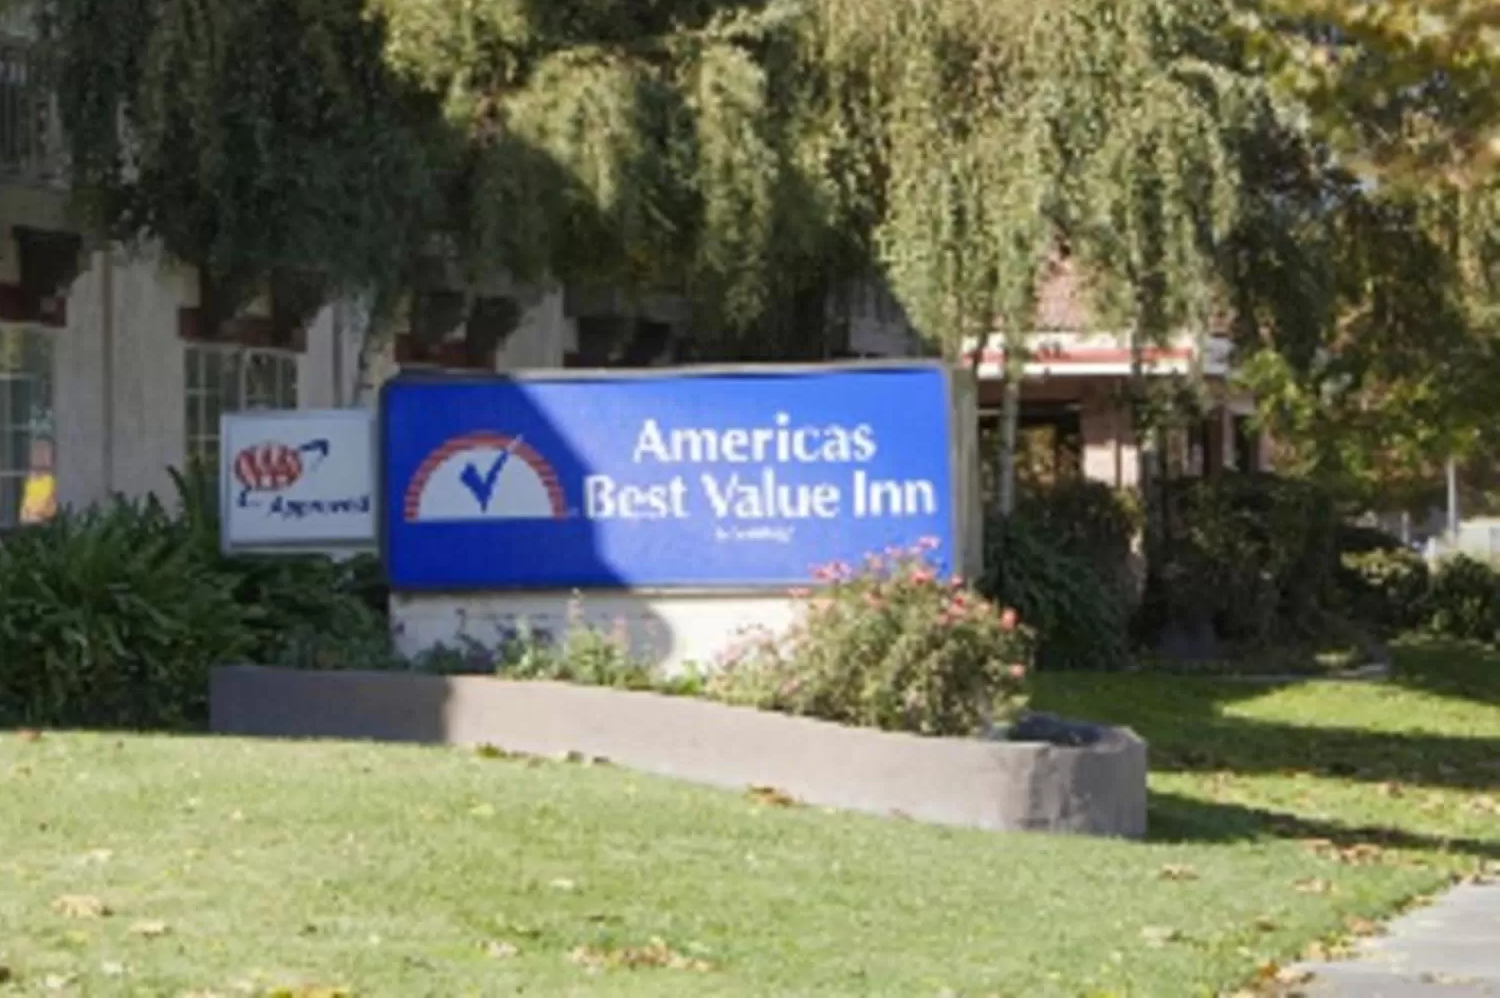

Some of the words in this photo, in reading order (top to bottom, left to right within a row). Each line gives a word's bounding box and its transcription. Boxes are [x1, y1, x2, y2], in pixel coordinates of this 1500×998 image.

[632, 411, 877, 464] Americas
[583, 473, 691, 520] Best
[701, 466, 842, 519] Value
[852, 469, 938, 519] Inn
